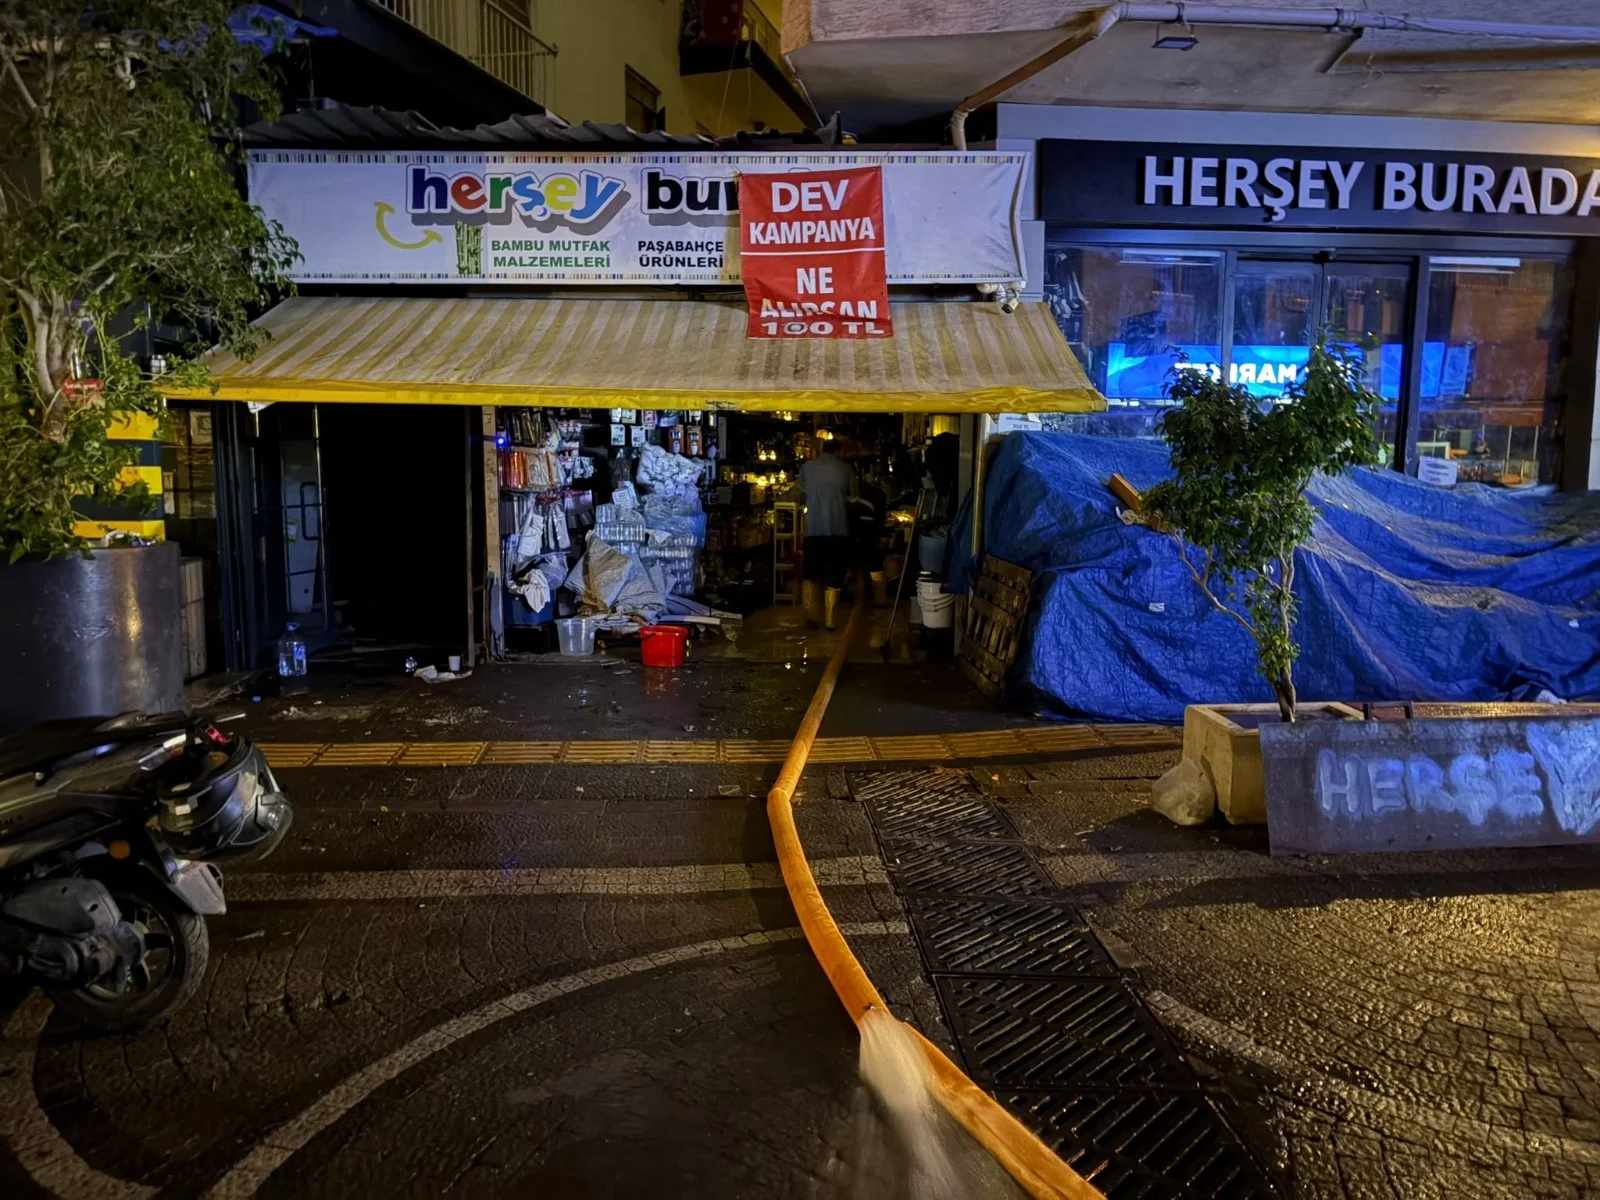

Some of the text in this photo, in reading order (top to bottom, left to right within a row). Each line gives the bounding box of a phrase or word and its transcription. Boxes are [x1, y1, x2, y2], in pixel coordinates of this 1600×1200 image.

[411, 167, 621, 219] herşey
[771, 179, 849, 213] DEV
[1144, 155, 1600, 221] HERŞEY BURADA
[750, 216, 875, 245] KAMPANYA
[491, 240, 610, 251] BAMBU MUTFAK
[637, 240, 724, 254] PAŞABAHÇE
[493, 255, 611, 268] MALZEMELERİ
[638, 255, 724, 268] ÜRÜNLERİ
[796, 266, 834, 295] NE
[760, 321, 885, 336] 100 TL
